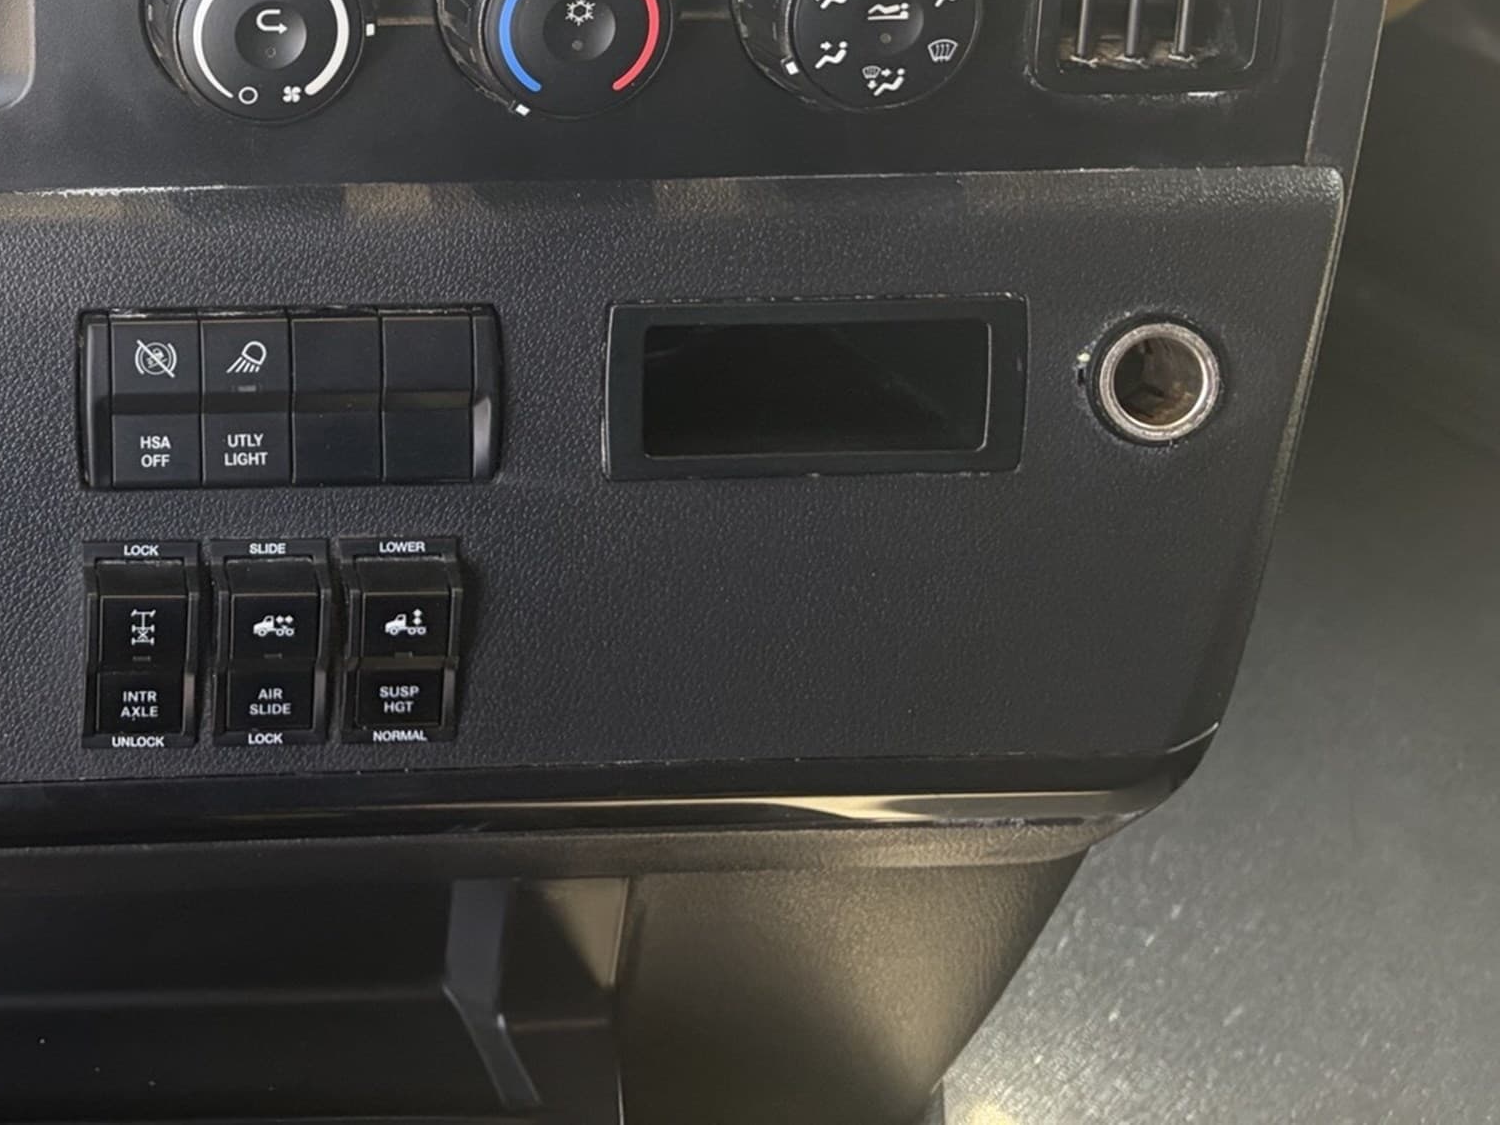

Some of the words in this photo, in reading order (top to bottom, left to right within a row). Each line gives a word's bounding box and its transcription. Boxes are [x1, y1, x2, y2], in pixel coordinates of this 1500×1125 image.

[139, 436, 171, 450] HSA
[226, 433, 264, 448] UTLY
[141, 454, 170, 468] OFF
[224, 451, 269, 466] LIGHT
[123, 545, 159, 556] LOCK
[249, 543, 286, 555] SLIDE
[379, 541, 426, 553] LOWER
[122, 690, 157, 703] INTR
[258, 688, 283, 701] AIR
[379, 686, 420, 698] SUSP
[120, 705, 159, 718] AXLE
[249, 702, 291, 716] SLIDE
[384, 700, 414, 713] HGT
[111, 735, 164, 748] UNLOCK
[248, 733, 283, 745] LOCK
[372, 730, 427, 742] NORMAL
